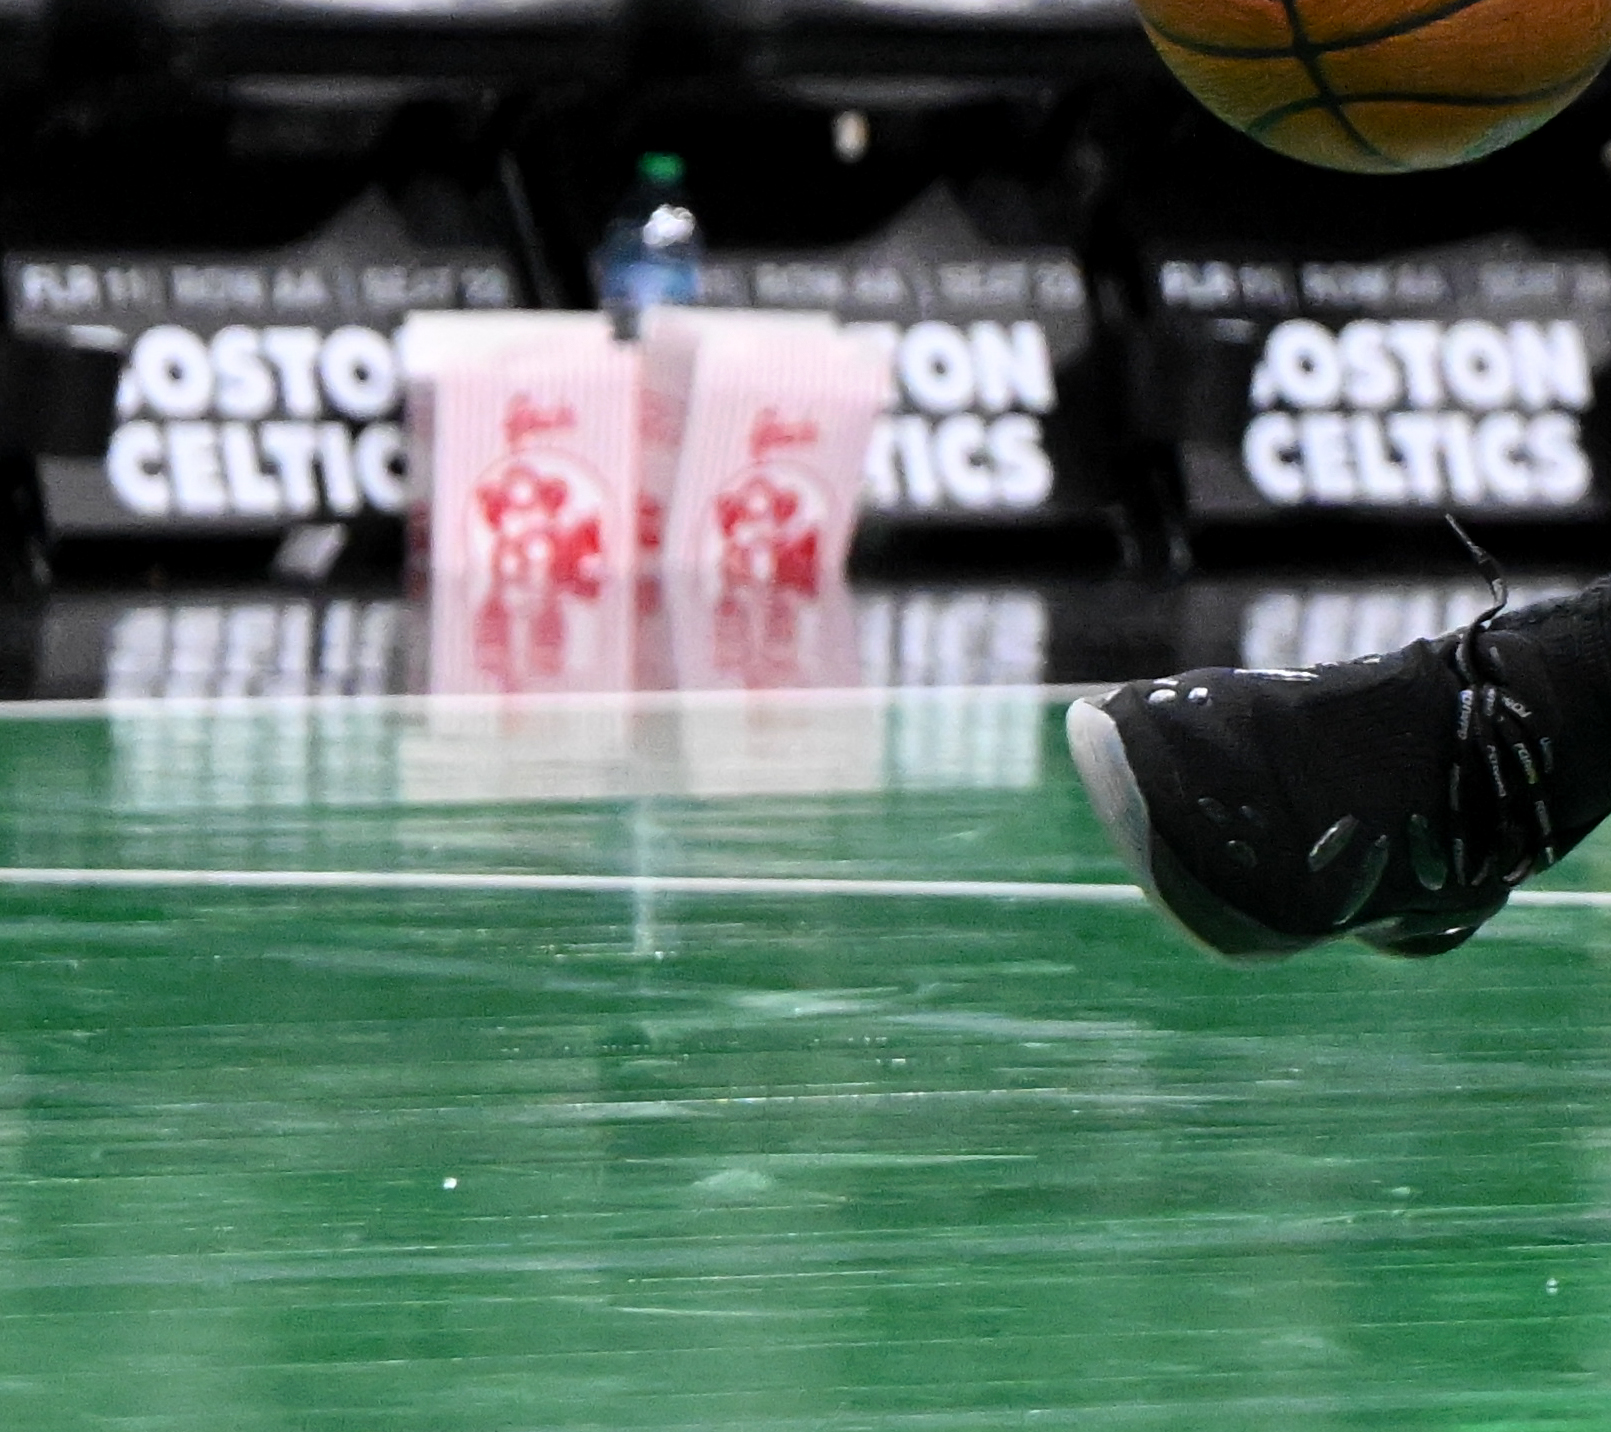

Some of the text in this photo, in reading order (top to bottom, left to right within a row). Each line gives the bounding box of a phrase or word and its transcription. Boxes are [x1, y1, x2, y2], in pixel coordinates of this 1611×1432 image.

[115, 323, 402, 420] OSTO
[106, 419, 412, 519] CELTIC
[866, 413, 1054, 510] TICS
[1242, 408, 1592, 506] CELTICS
